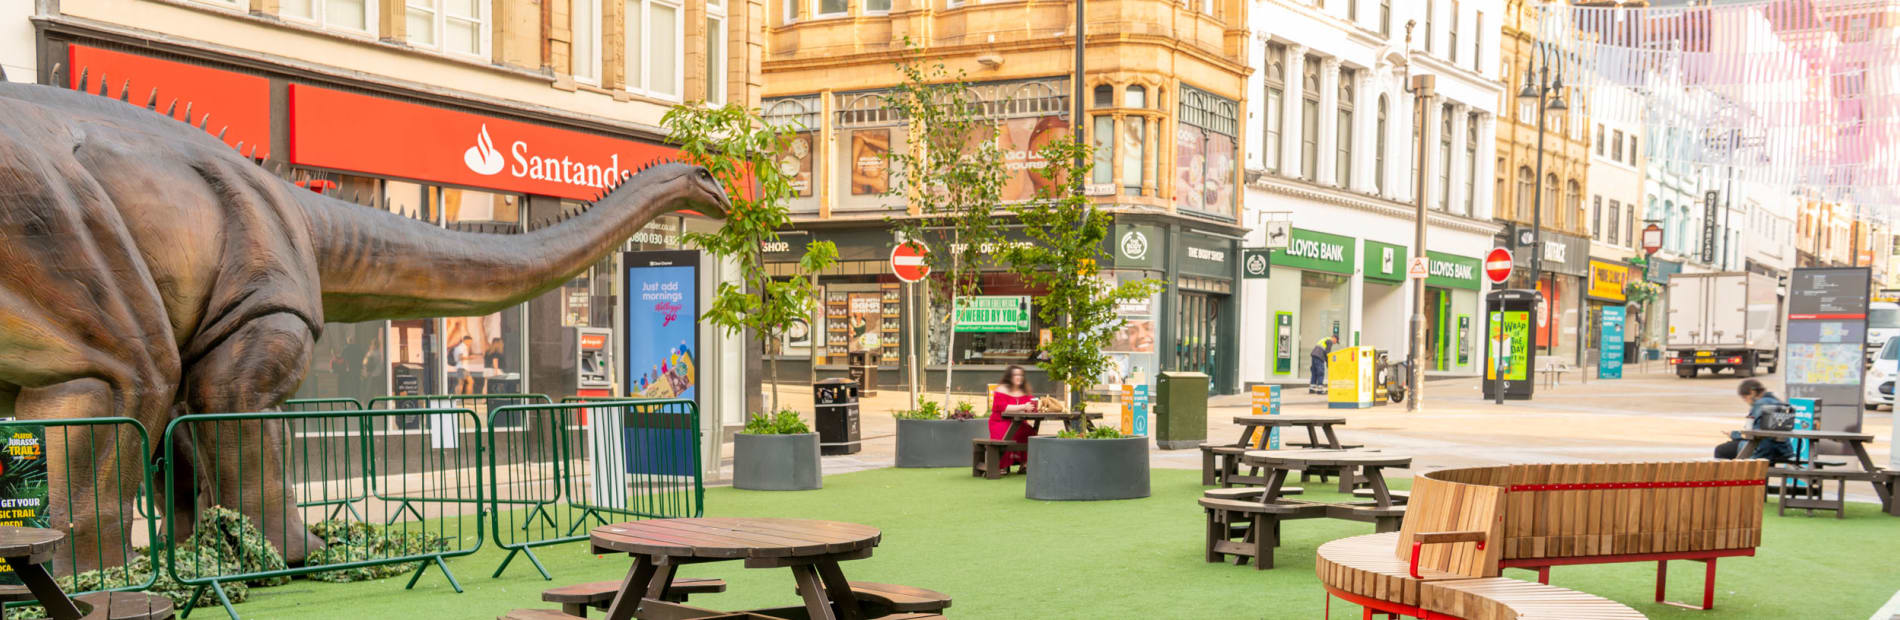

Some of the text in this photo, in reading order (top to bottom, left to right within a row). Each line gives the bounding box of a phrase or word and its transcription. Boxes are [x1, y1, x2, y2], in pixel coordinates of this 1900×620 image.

[511, 140, 635, 189] Santand
[1320, 242, 1344, 262] BANK
[1430, 260, 1472, 280] LLOYDS BANK
[642, 281, 679, 292] Just add
[642, 291, 682, 302] mornings
[955, 309, 1016, 322] POWERED BY YOU
[8, 437, 39, 446] JURASSIC
[9, 444, 41, 456] TRAIL 2
[1, 498, 40, 507] GET YOUR
[11, 508, 36, 518] TRAIL
